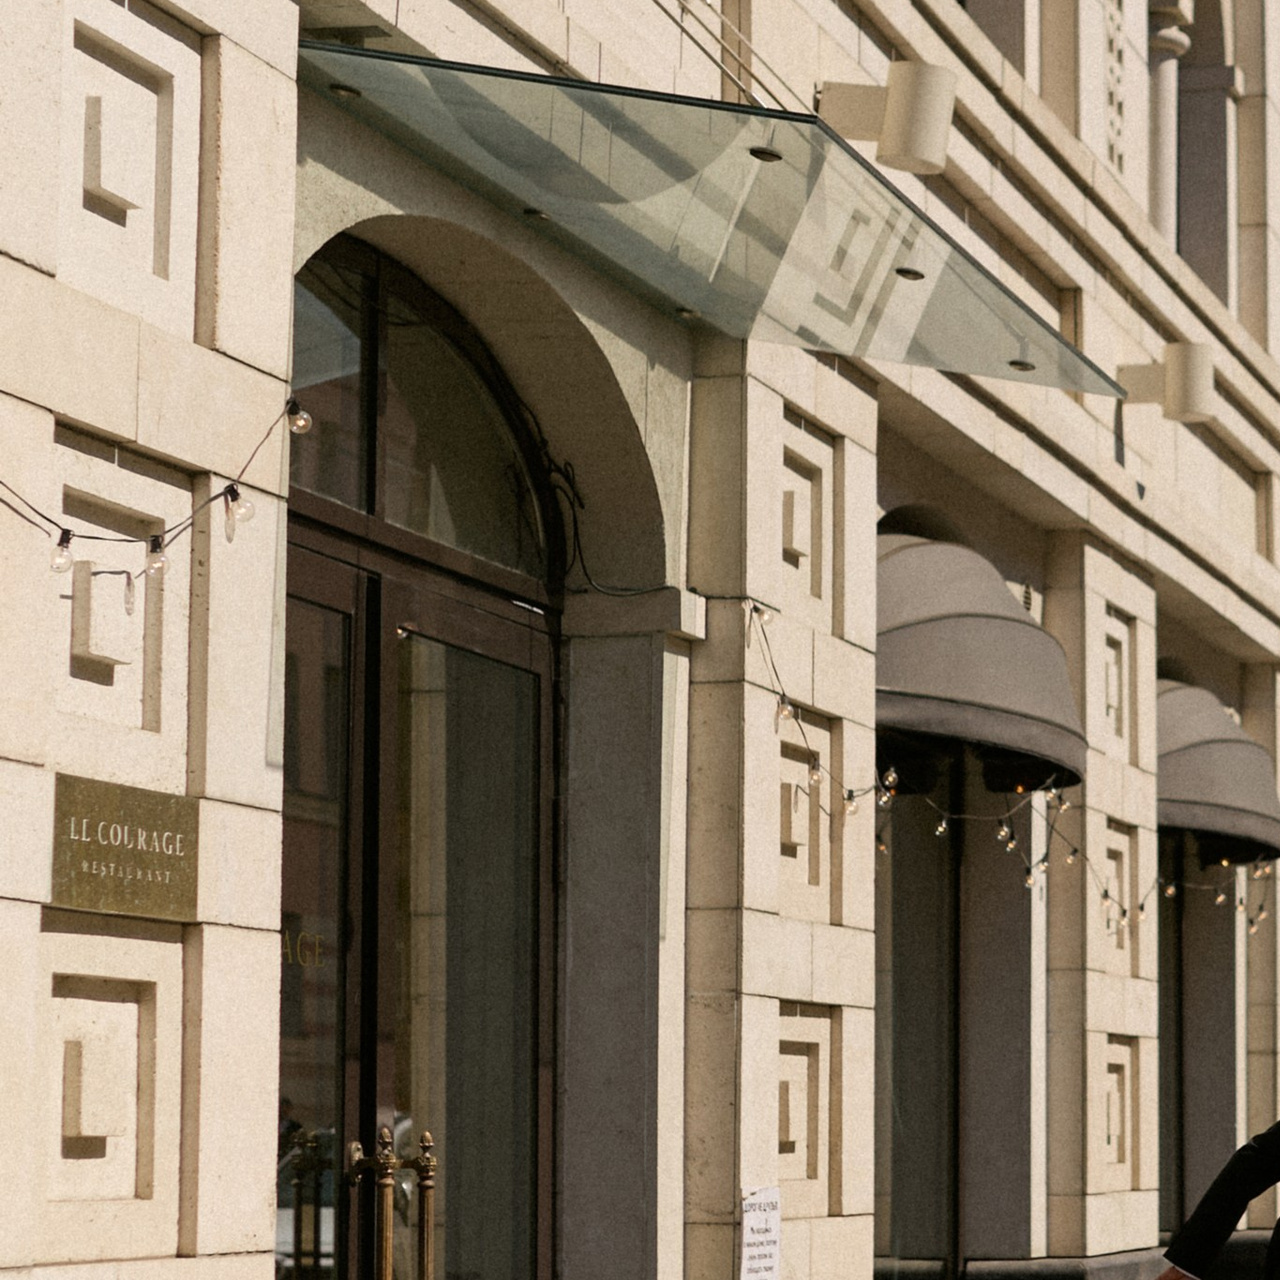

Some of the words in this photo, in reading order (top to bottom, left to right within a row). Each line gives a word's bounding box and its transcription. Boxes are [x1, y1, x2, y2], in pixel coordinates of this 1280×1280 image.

[69, 817, 91, 842] LE
[97, 821, 185, 857] COURAGE
[81, 859, 171, 884] RESTAURANT
